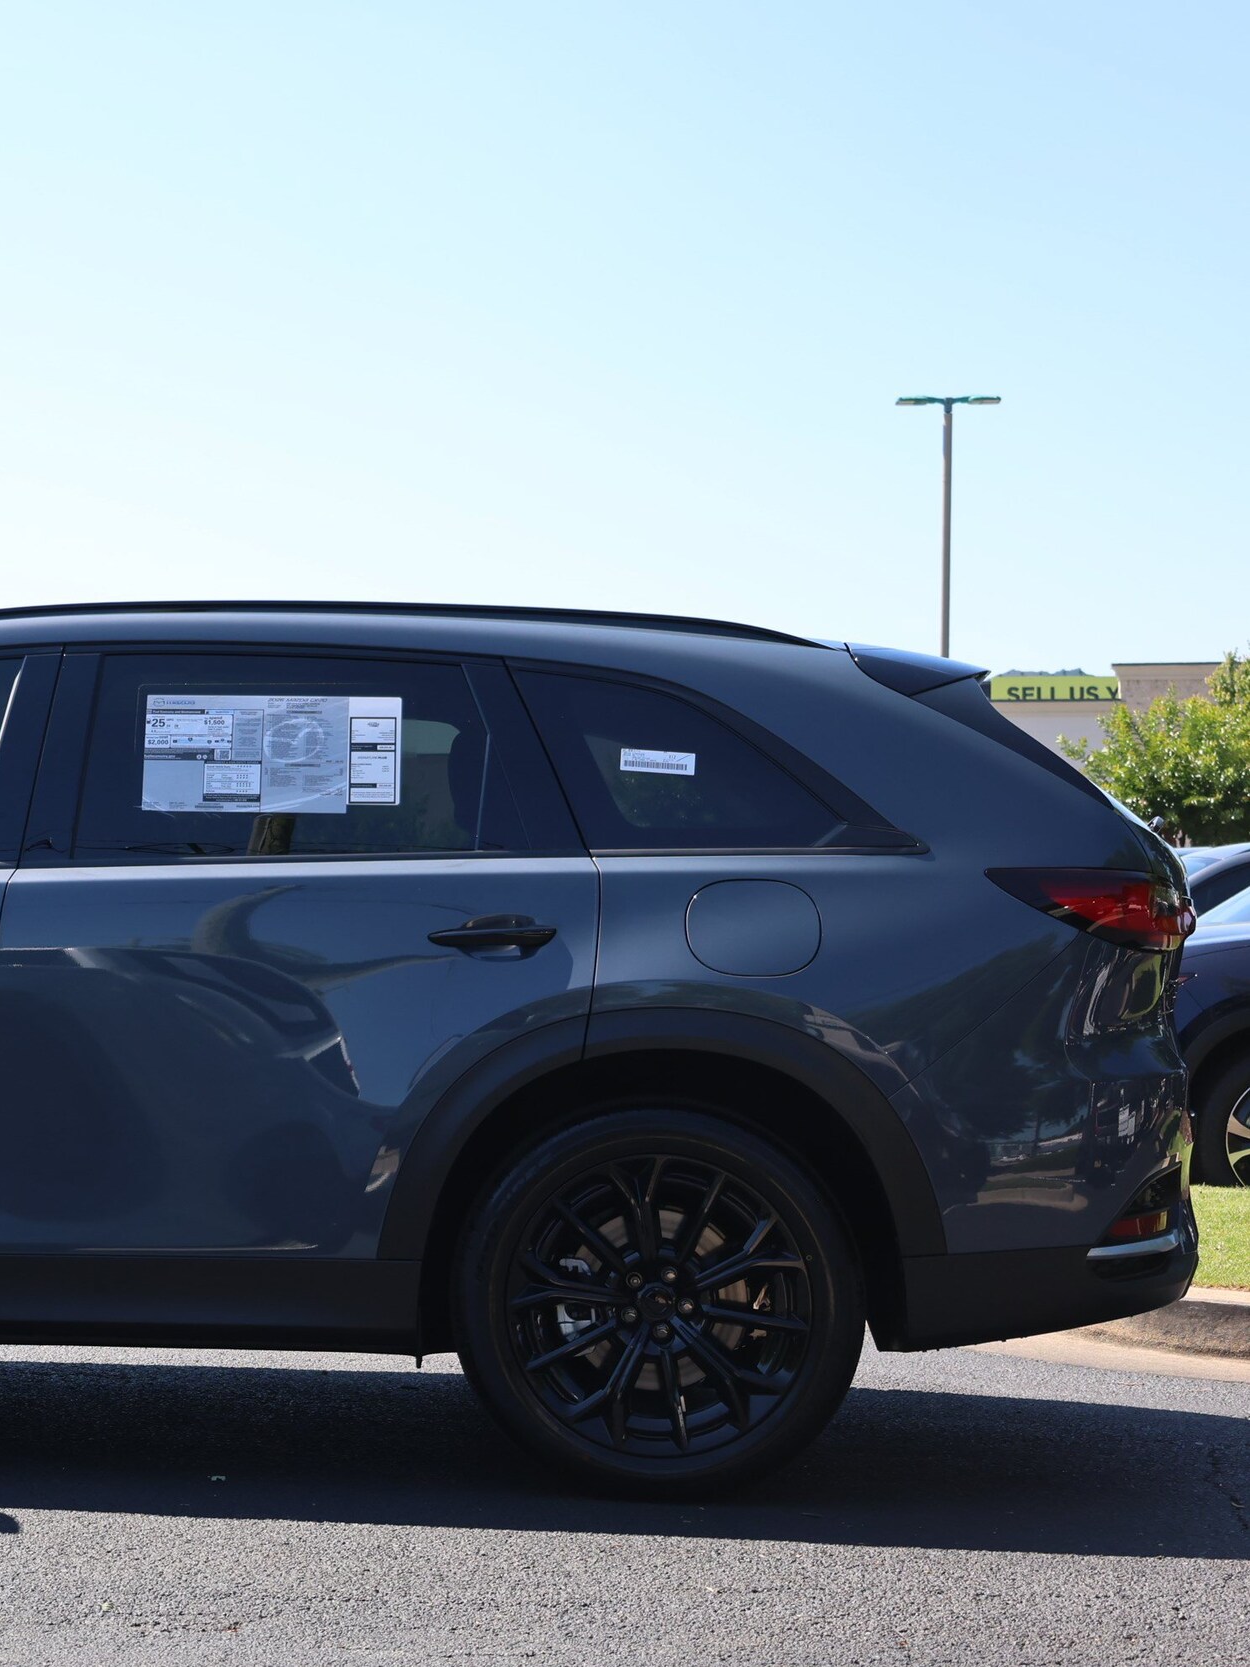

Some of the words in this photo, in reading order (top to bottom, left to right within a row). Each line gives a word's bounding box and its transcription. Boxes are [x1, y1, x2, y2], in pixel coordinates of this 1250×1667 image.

[1007, 686, 1054, 700] SELL
[1069, 686, 1098, 700] US
[151, 718, 166, 727] 25
